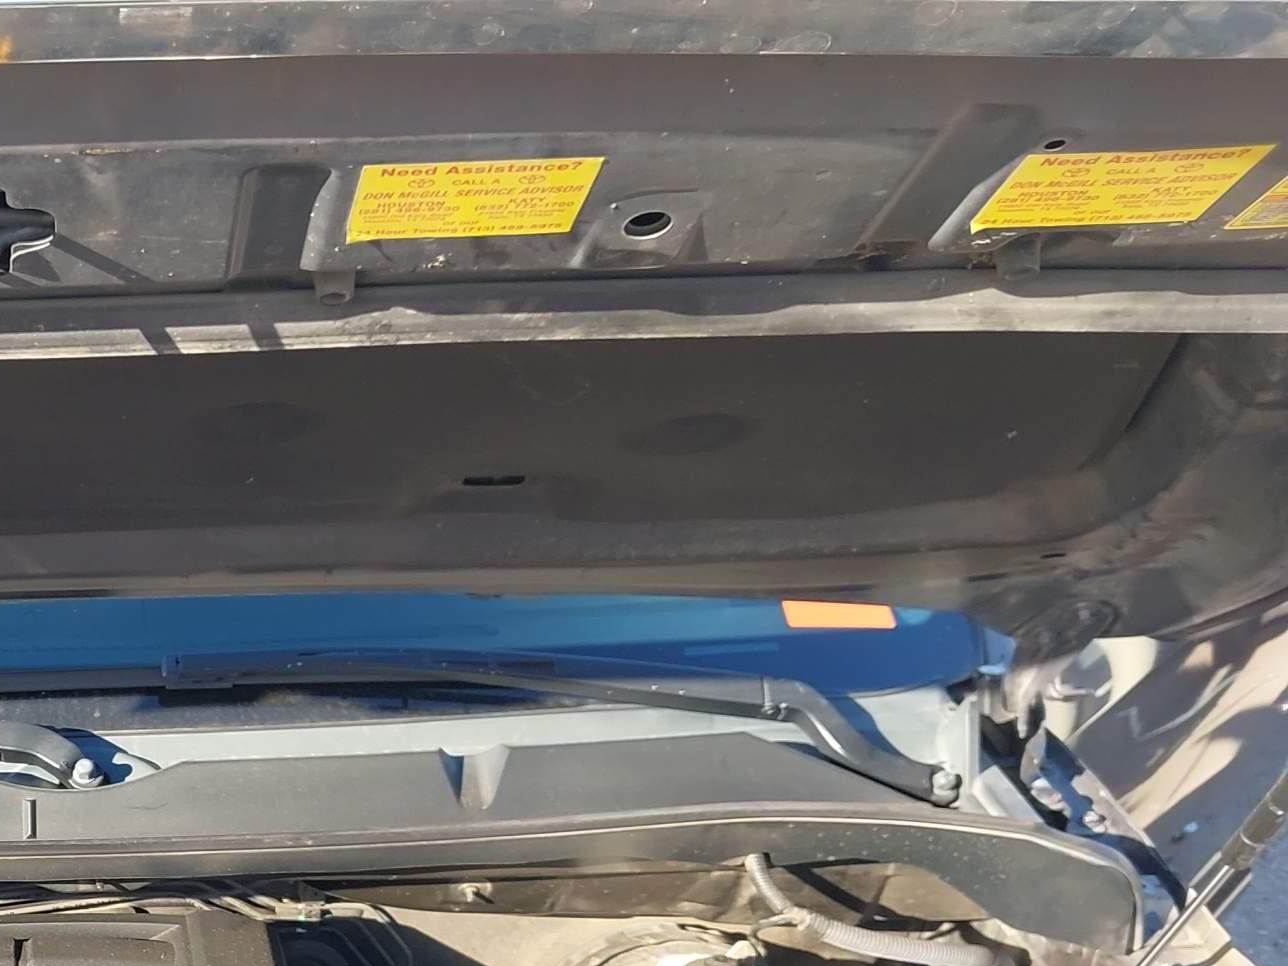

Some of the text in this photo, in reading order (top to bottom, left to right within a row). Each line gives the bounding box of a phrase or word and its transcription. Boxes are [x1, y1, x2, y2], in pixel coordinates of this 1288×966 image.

[1040, 149, 1253, 167] Need Assistance?
[381, 161, 583, 177] Need Assistance?
[452, 178, 488, 186] CALL
[363, 192, 394, 200] DON
[455, 187, 516, 197] SERVICE
[519, 184, 585, 194] ADVISOR
